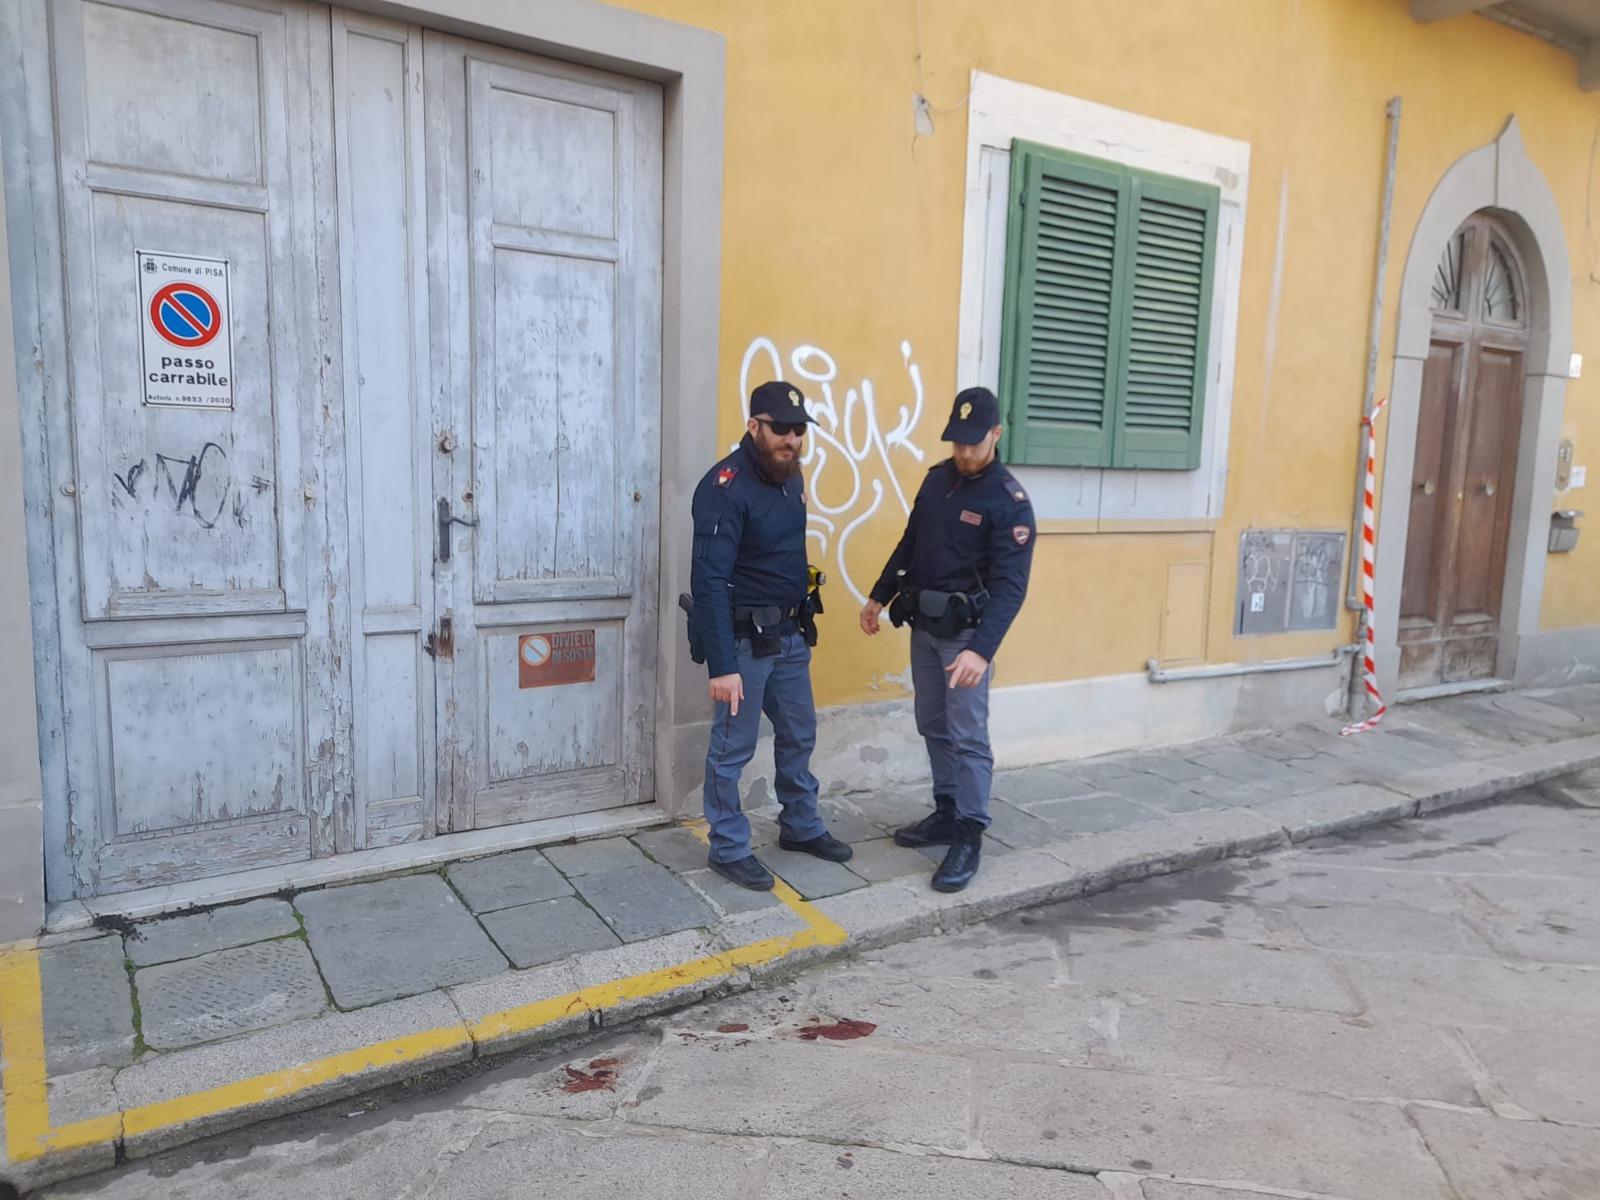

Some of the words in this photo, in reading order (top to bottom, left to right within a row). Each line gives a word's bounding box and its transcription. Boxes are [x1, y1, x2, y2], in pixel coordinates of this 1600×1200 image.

[162, 263, 192, 274] Comune
[195, 266, 202, 275] di
[205, 267, 224, 277] PISA
[161, 356, 214, 369] passo
[149, 372, 228, 386] carrabile
[552, 631, 593, 648] DIVIETO
